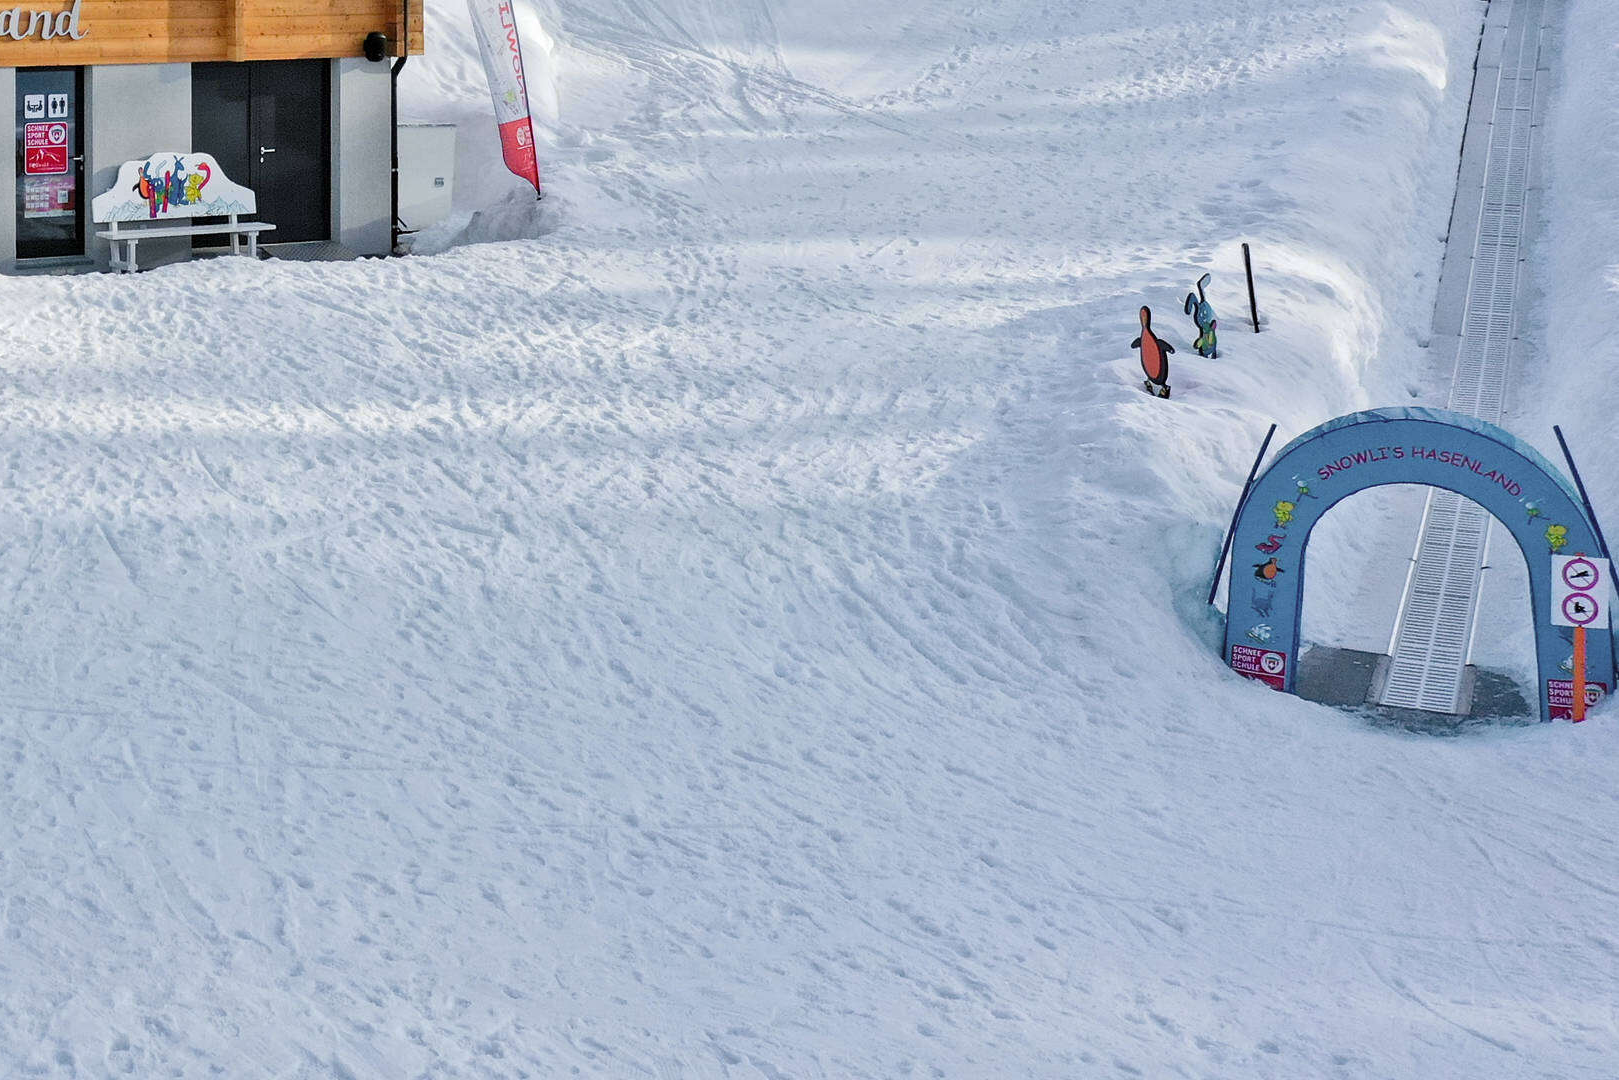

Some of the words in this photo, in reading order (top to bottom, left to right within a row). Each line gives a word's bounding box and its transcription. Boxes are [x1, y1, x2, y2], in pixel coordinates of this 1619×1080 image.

[1317, 446, 1404, 481] SNOWLI'S
[1411, 446, 1523, 497] HASENLAND
[1232, 646, 1262, 657] SCHNEE
[1232, 654, 1256, 663] SPORT
[1232, 661, 1261, 671] SCHULE
[1548, 696, 1573, 704] SCHU
